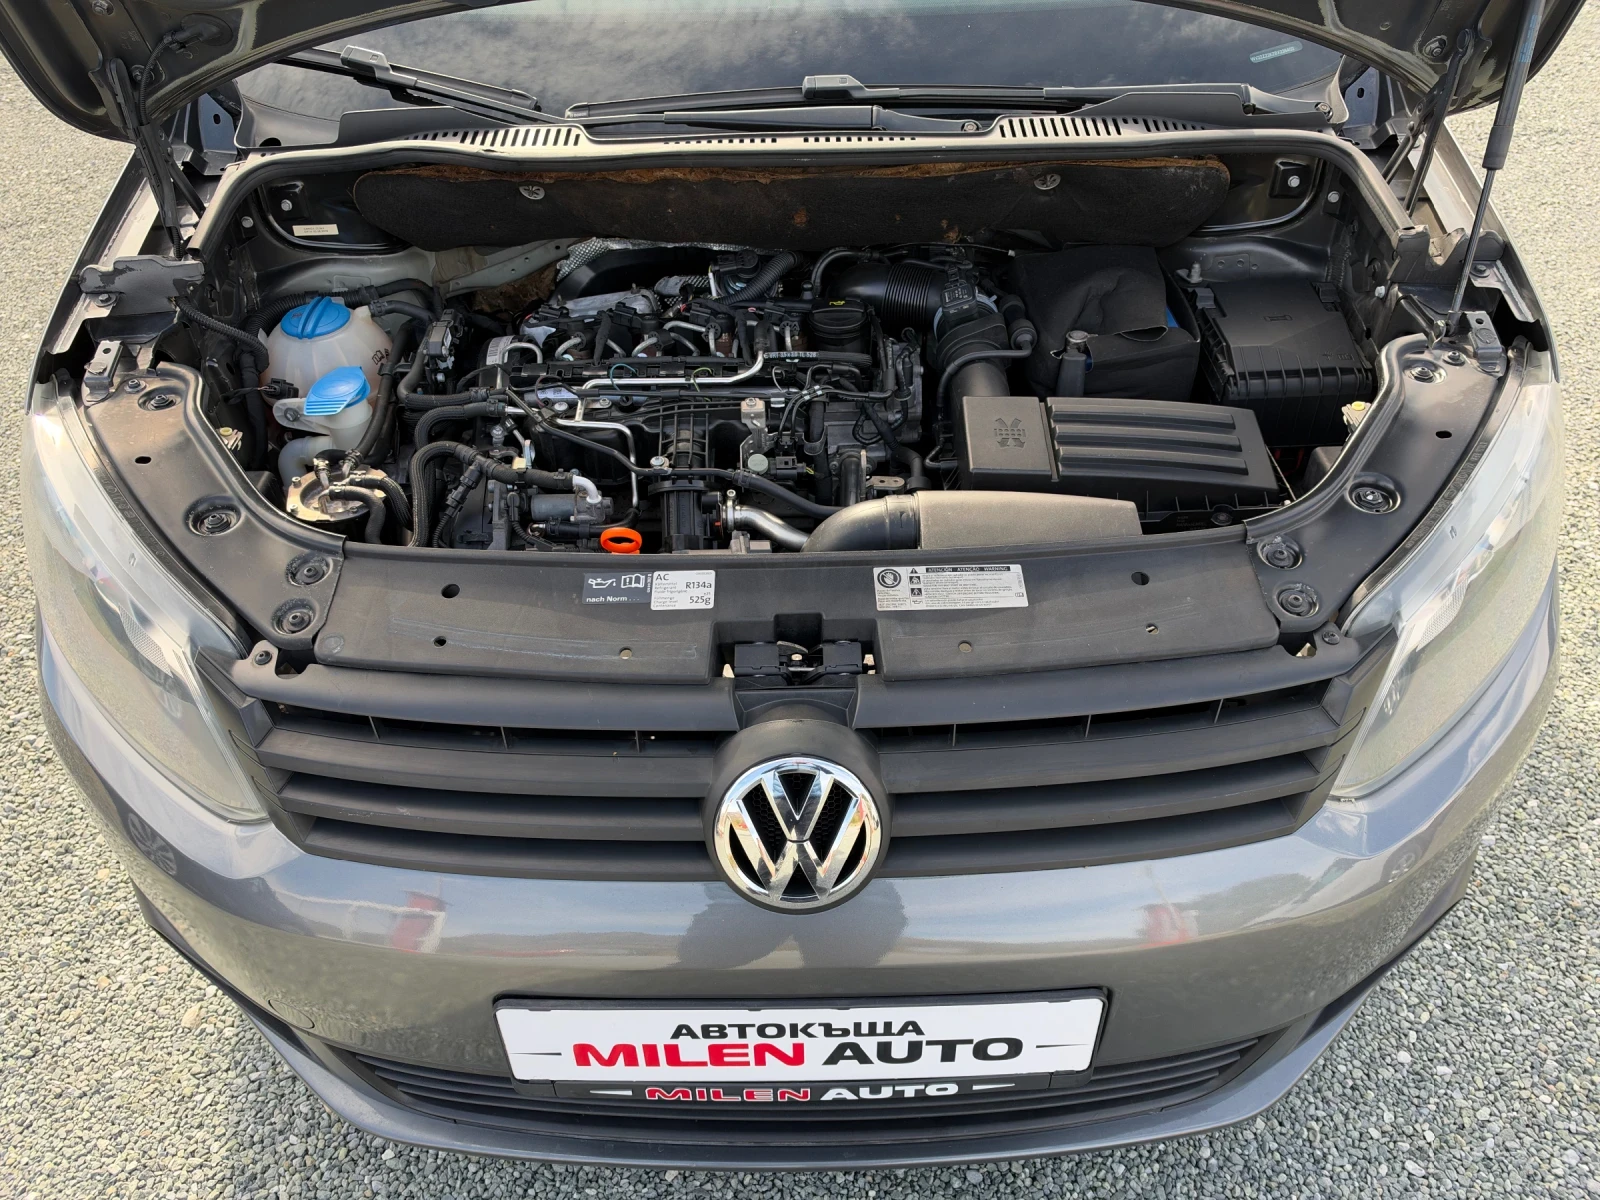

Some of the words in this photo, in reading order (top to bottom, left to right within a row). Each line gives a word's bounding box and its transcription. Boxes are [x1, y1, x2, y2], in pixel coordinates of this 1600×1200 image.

[655, 573, 670, 581] AC
[685, 581, 712, 589] R134a
[689, 596, 711, 606] 525g
[573, 1042, 805, 1067] MILEN
[822, 1037, 1023, 1066] AUTO
[646, 1087, 811, 1102] MILEN
[820, 1083, 959, 1101] AUTO
